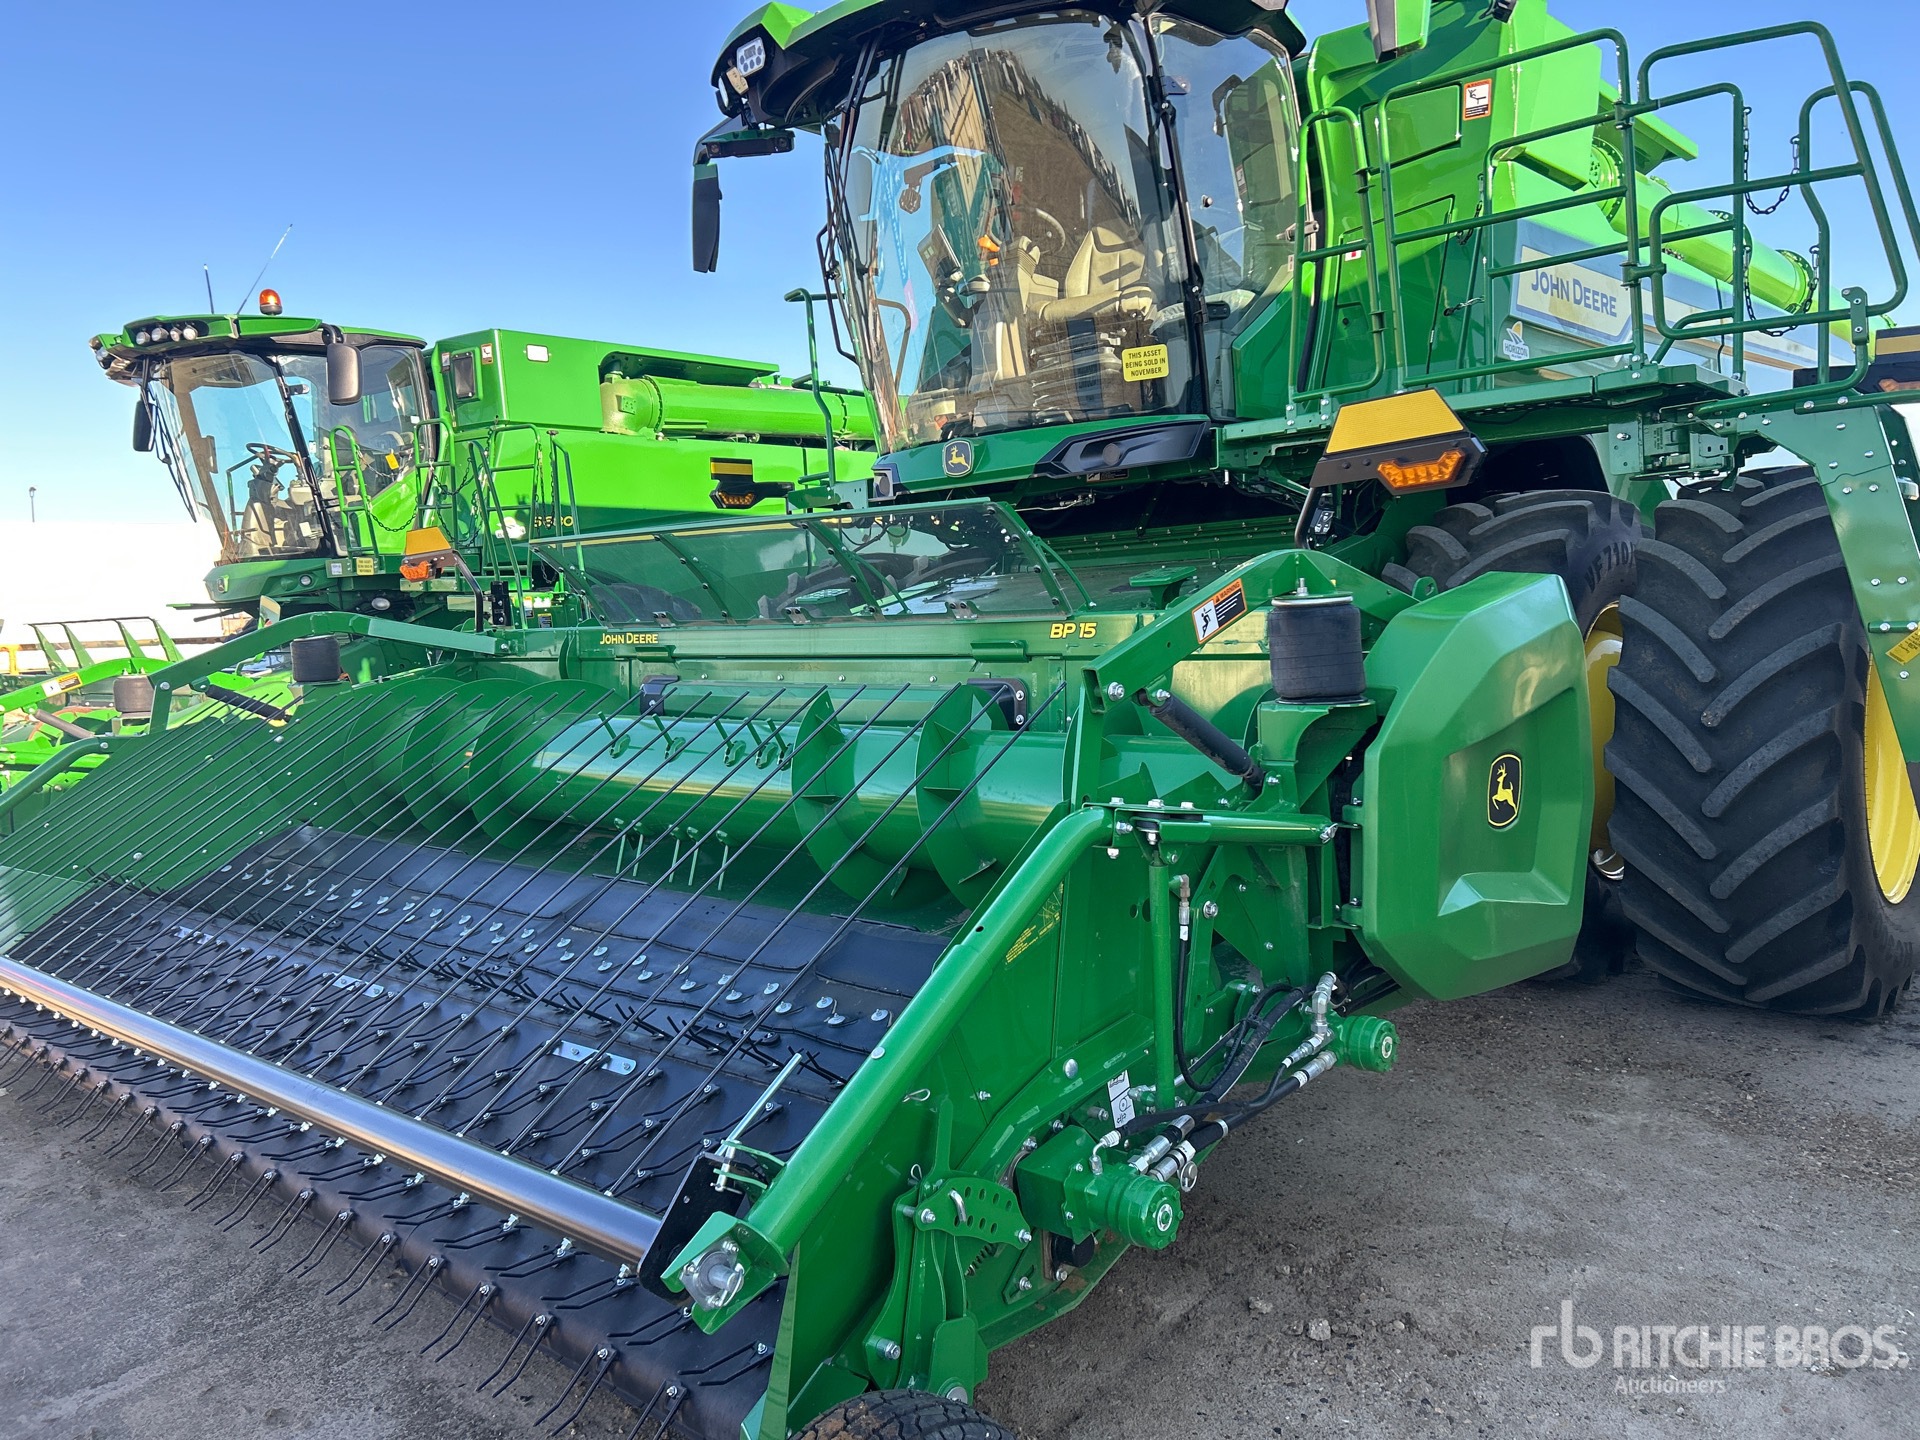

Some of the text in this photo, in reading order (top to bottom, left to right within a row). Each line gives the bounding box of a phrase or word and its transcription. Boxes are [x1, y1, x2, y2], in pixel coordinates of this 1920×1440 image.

[1531, 269, 1617, 318] JOHN DEERE
[1128, 349, 1162, 360] THIS ASSET
[1125, 360, 1143, 369] BEING
[1144, 359, 1159, 367] SOLD
[1131, 366, 1162, 377] NOVEMBER
[1049, 622, 1098, 639] BP 15
[600, 632, 659, 645] JOHN DEERE
